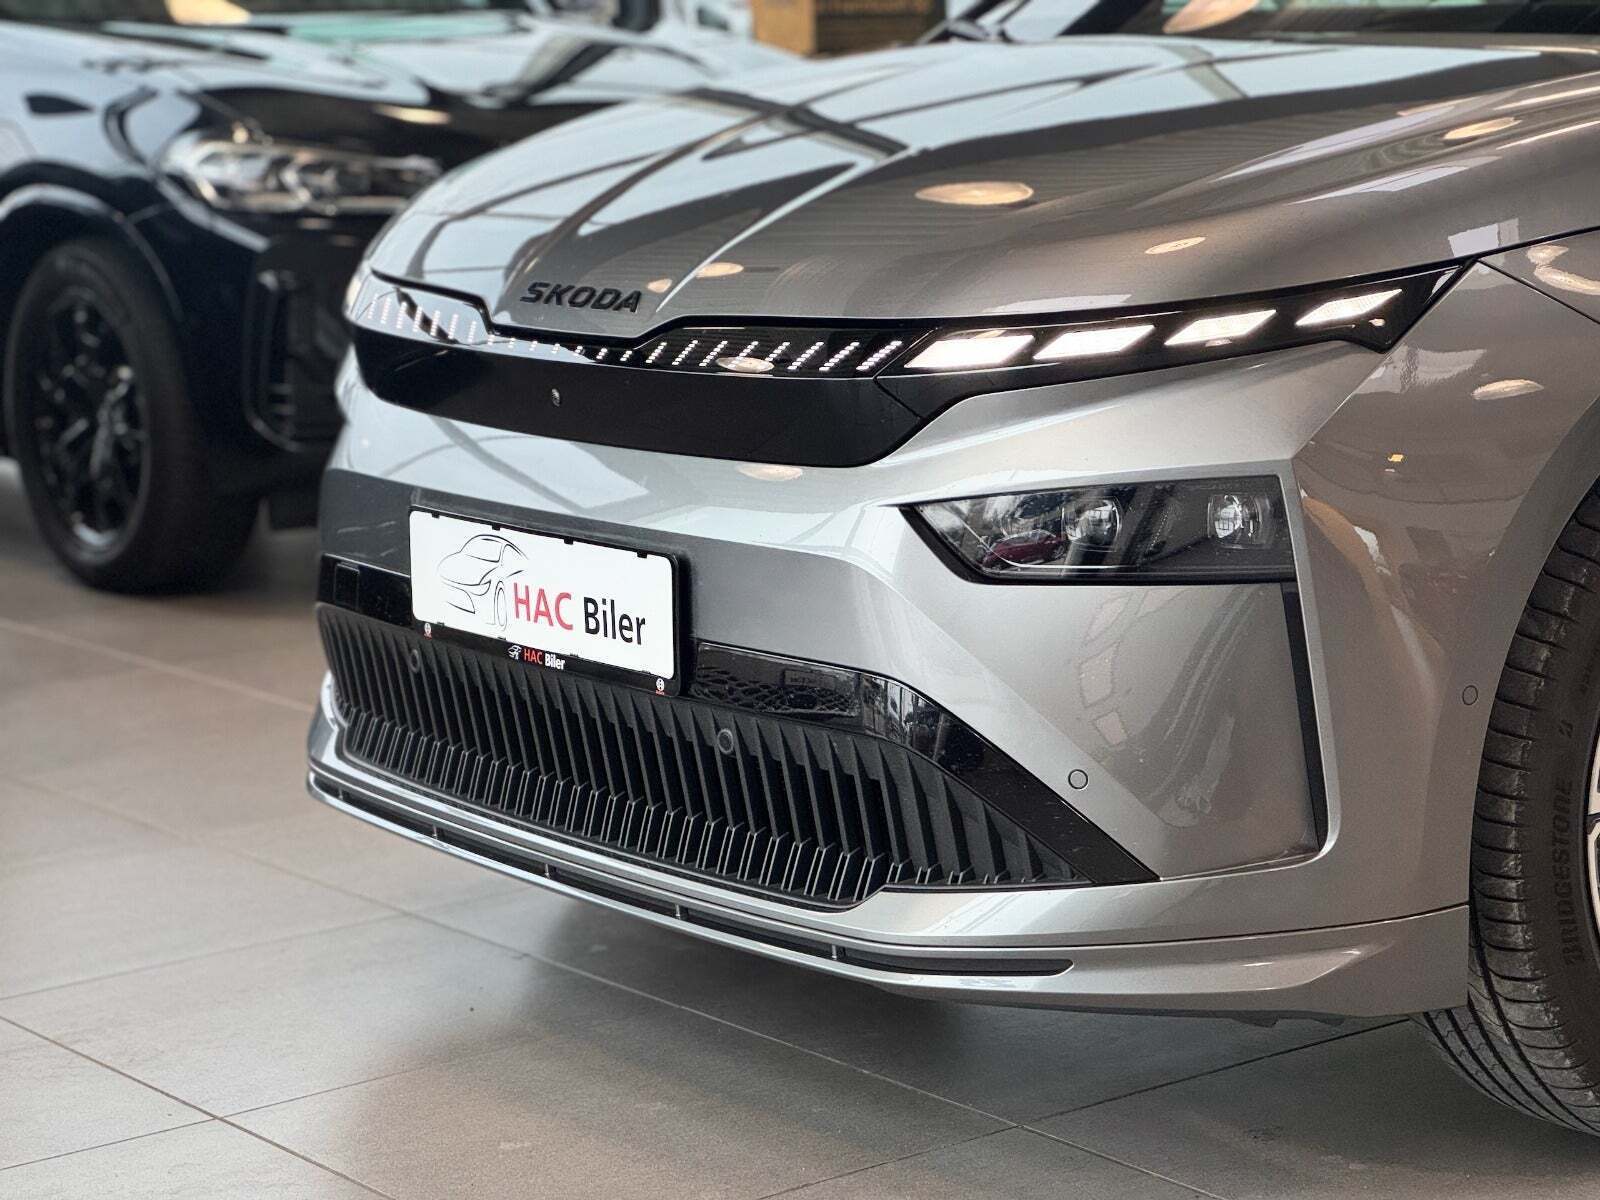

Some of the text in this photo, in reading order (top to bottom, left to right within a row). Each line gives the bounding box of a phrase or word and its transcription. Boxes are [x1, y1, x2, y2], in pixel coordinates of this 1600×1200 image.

[520, 282, 641, 312] SKODA
[513, 582, 646, 645] HAC Biler
[524, 648, 566, 670] HAC Biler
[1552, 778, 1583, 966] BRIDGESTONE
